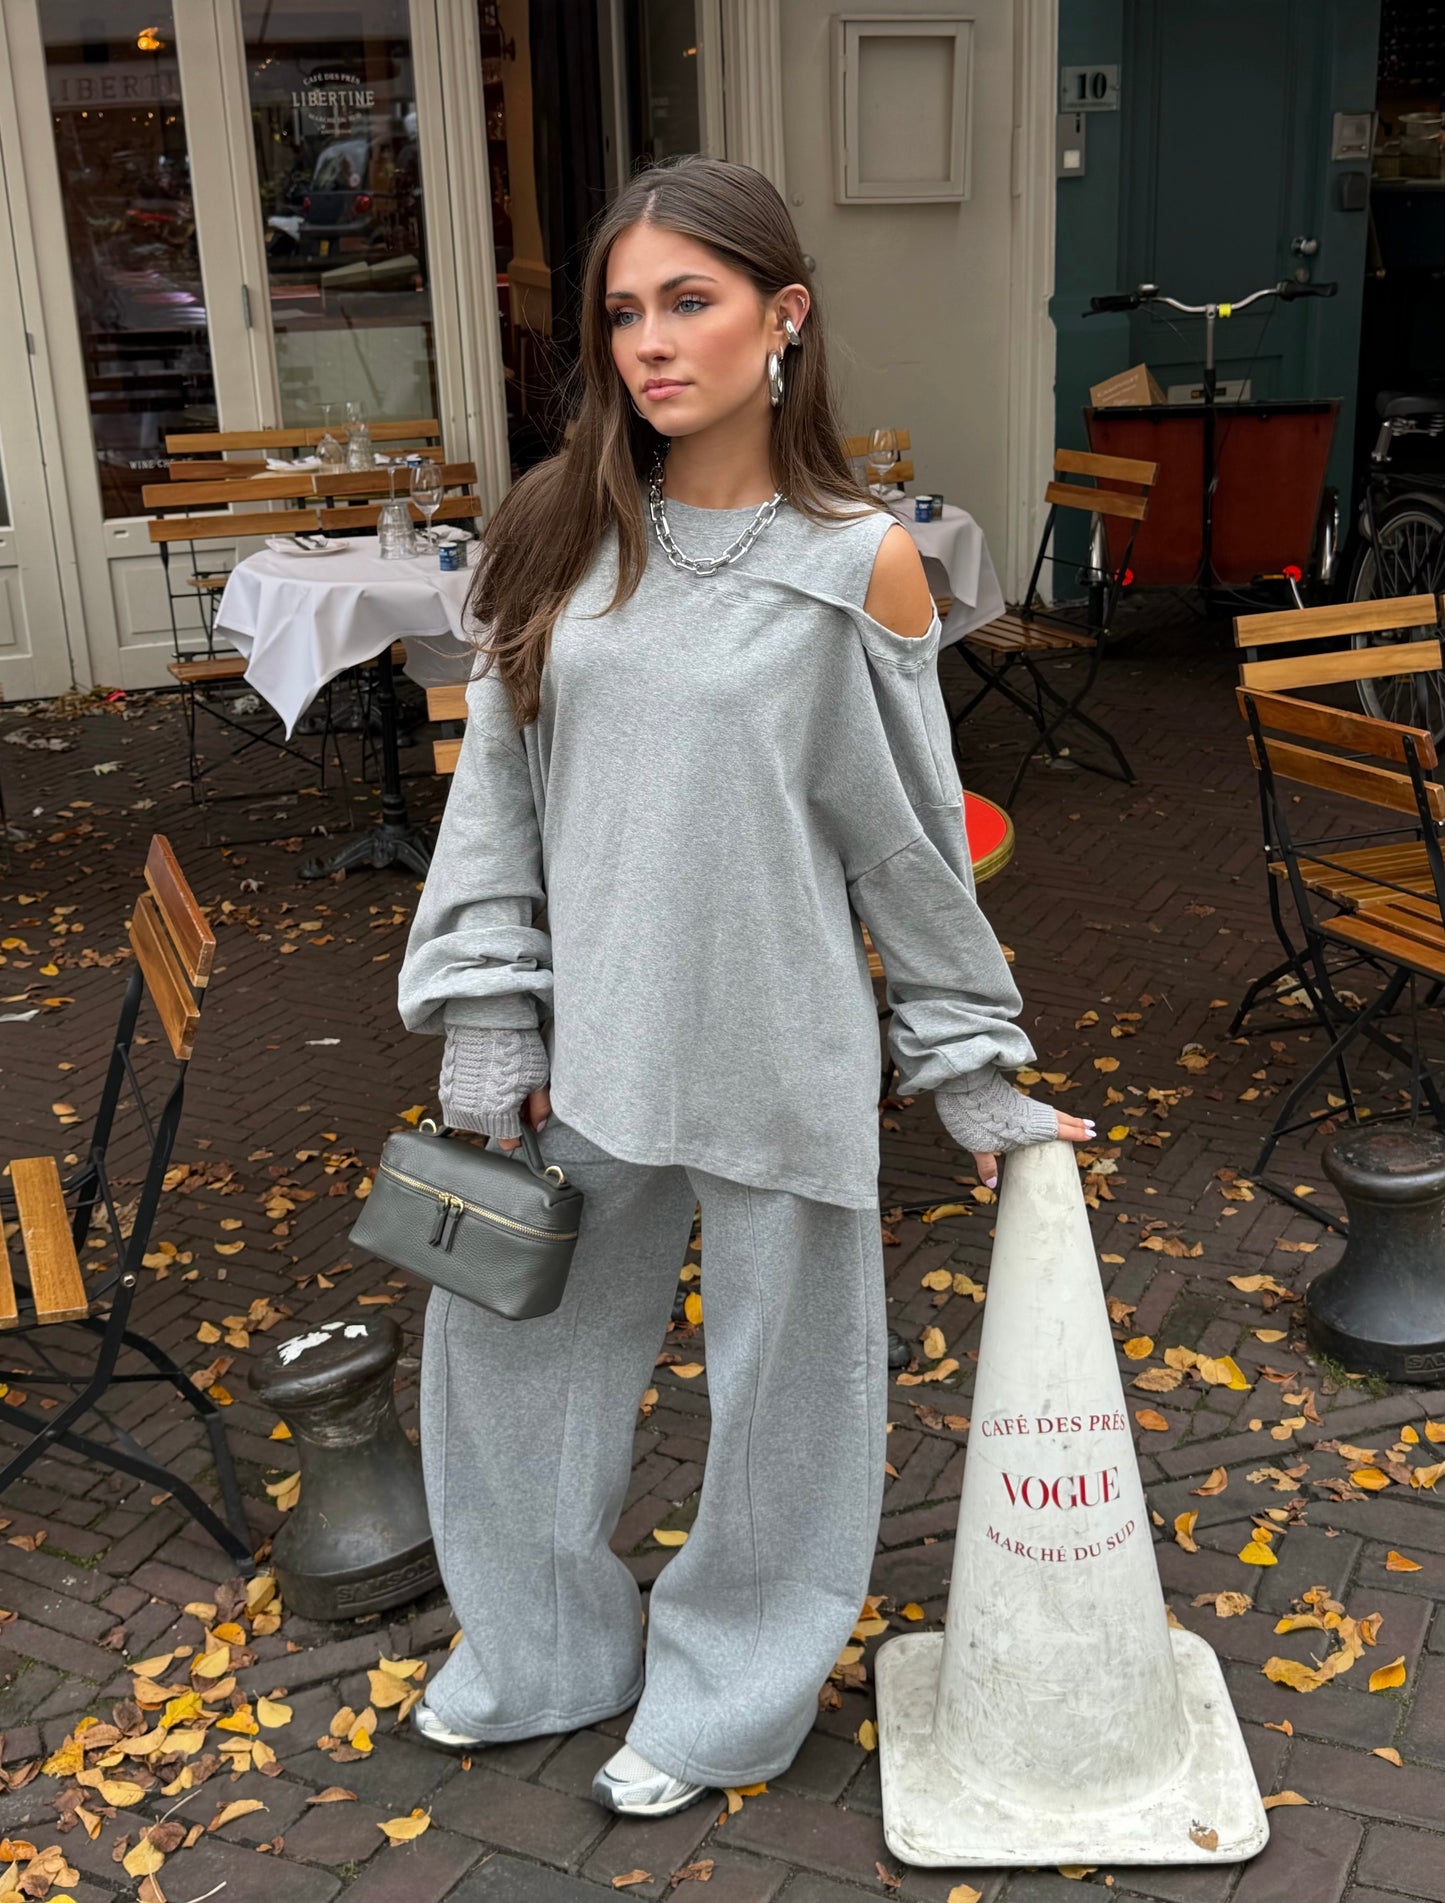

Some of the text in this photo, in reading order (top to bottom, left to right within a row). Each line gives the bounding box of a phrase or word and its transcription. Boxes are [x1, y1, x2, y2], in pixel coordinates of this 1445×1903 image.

[292, 91, 375, 107] LIBERTINE
[1077, 72, 1107, 100] 10
[129, 460, 155, 470] WINE
[981, 1409, 1126, 1437] CAFÉ DES PRÉS
[1001, 1466, 1121, 1511] VOGUE
[986, 1519, 1136, 1563] MARCHÉ DU SUD
